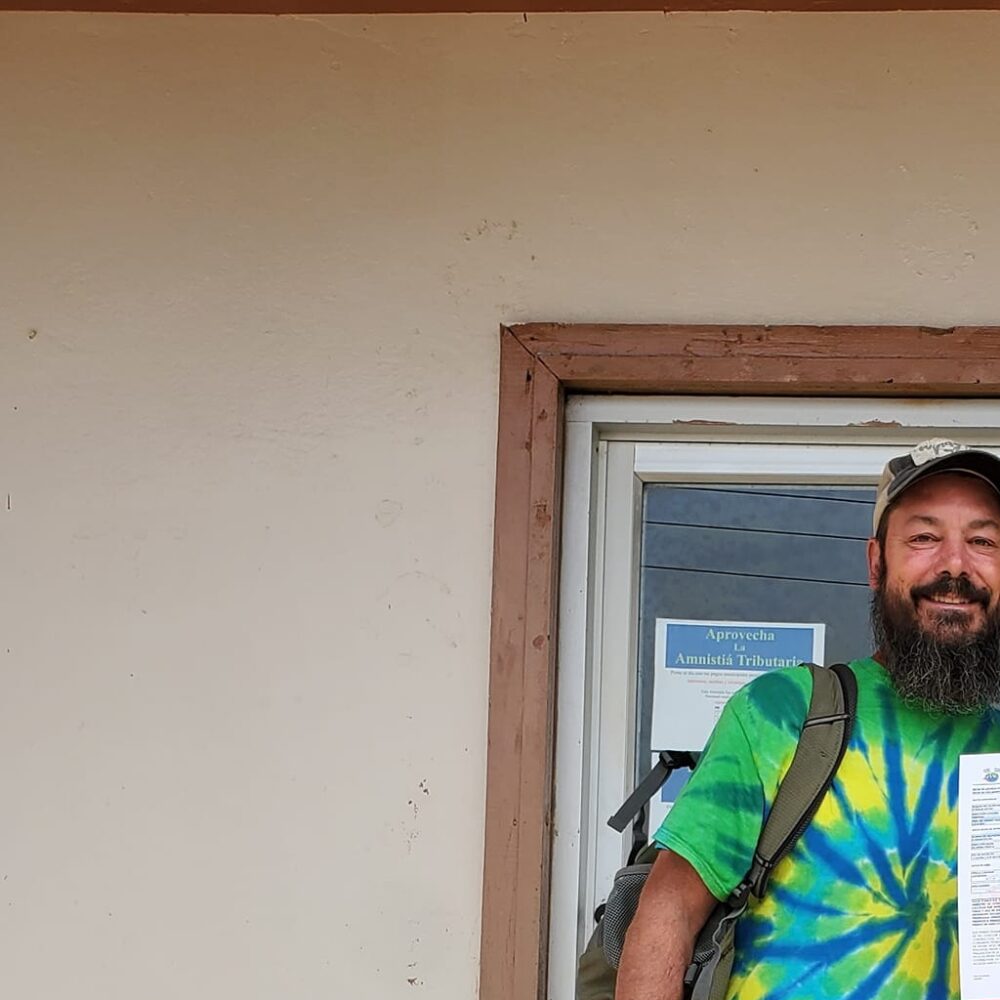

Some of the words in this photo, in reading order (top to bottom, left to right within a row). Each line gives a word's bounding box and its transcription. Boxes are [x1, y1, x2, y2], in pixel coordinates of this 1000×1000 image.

[705, 628, 775, 642] Aprovecha
[734, 643, 745, 651] La
[675, 652, 733, 666] Amnistiá
